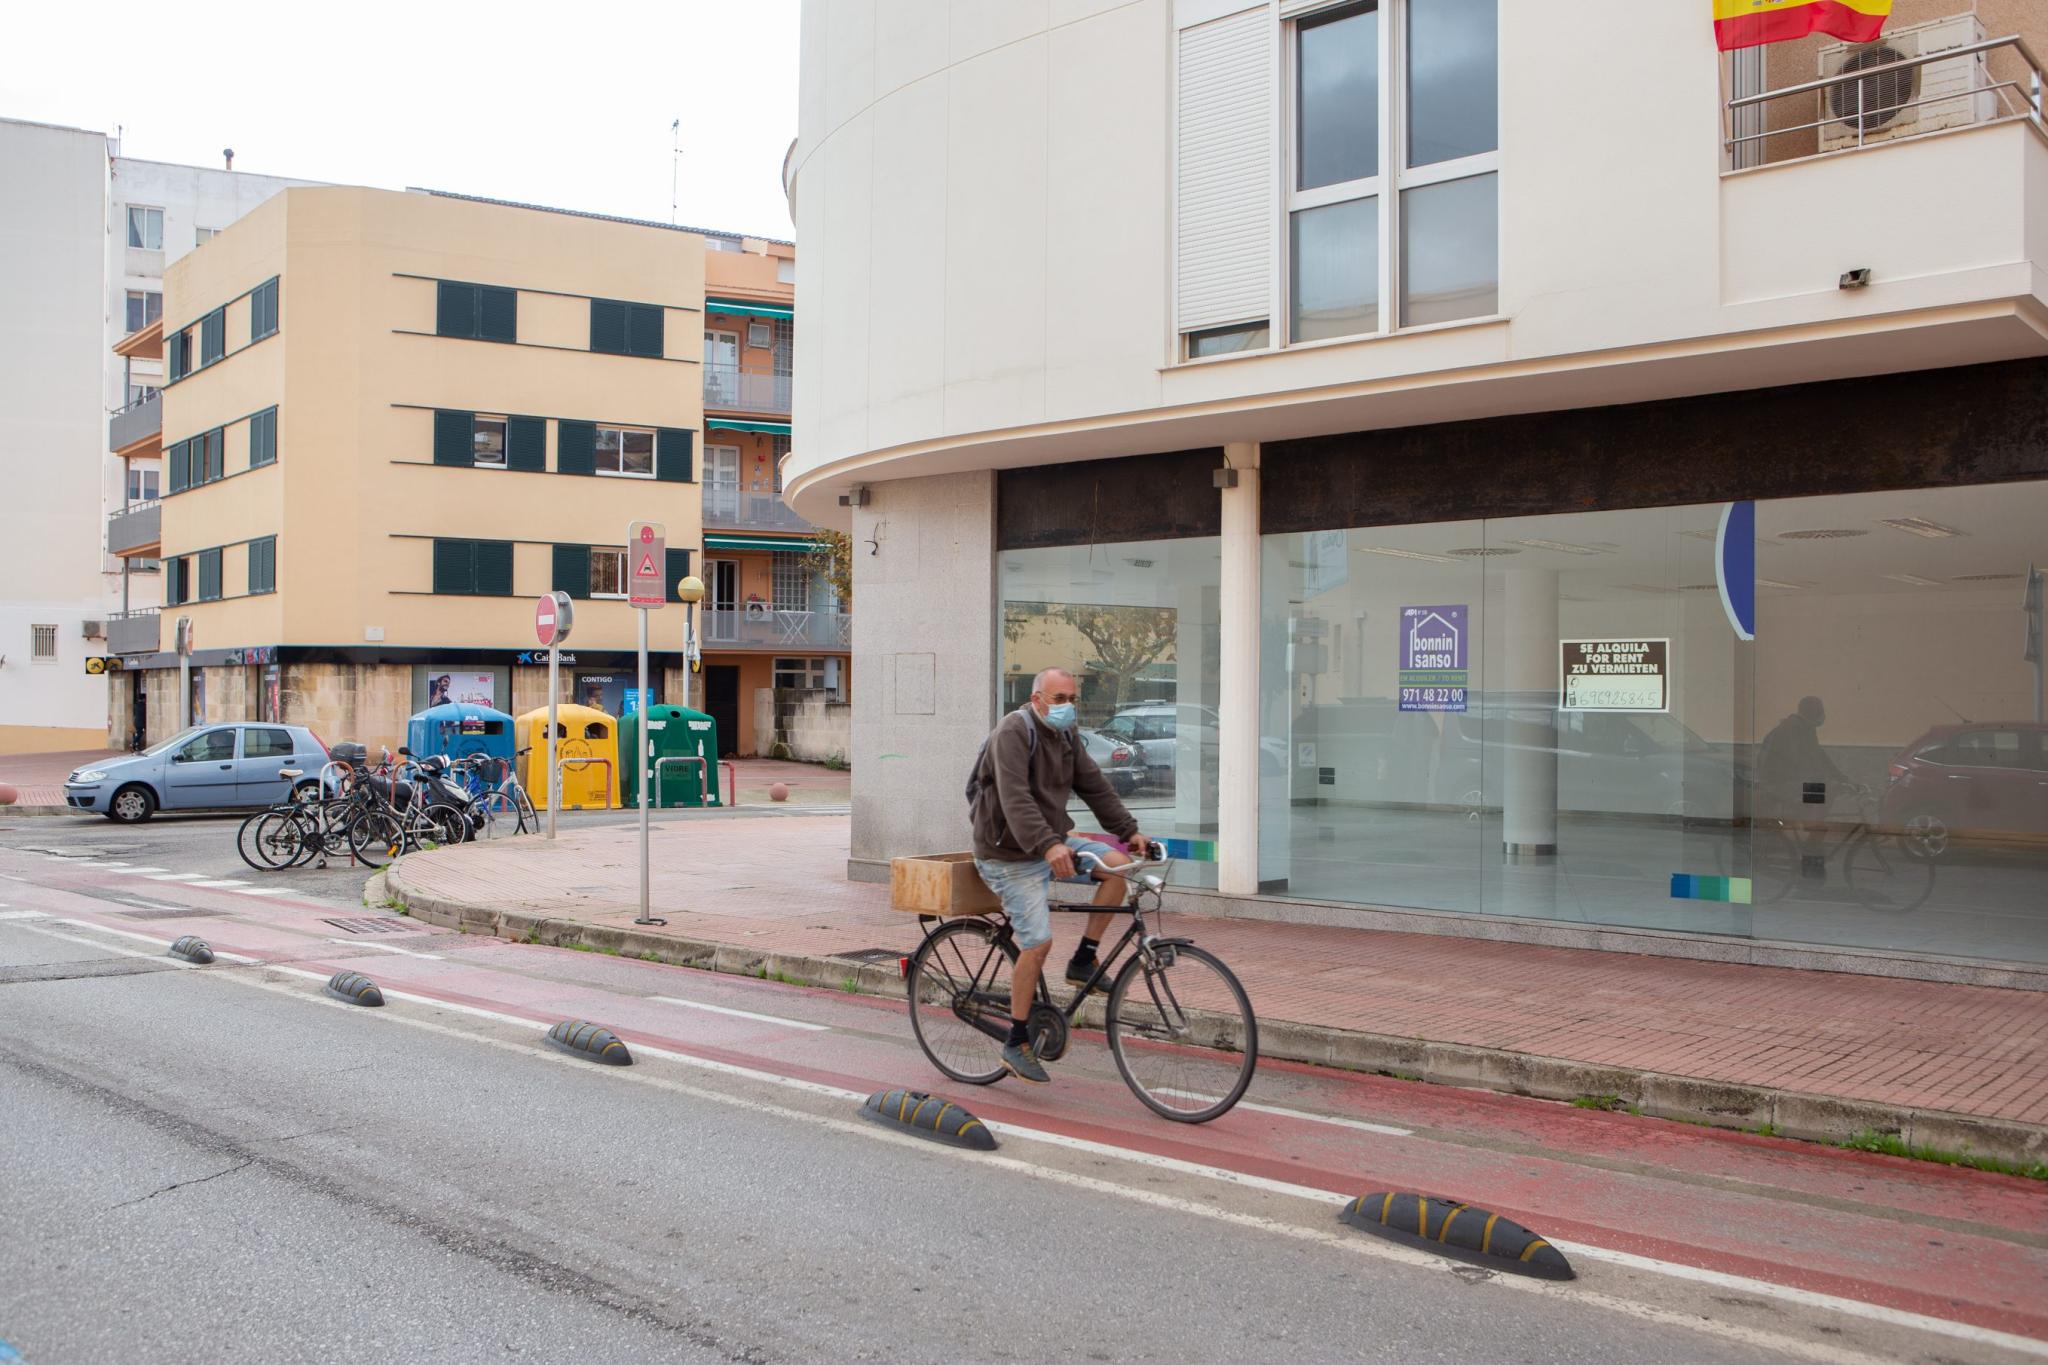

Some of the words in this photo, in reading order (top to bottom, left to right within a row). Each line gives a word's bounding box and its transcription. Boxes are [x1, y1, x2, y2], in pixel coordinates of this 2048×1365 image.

[1413, 632, 1453, 651] bonnin
[1580, 643, 1593, 653] SE
[1596, 643, 1650, 653] ALQUILA
[534, 652, 576, 662] CaiBank
[1414, 654, 1451, 668] sanso
[1586, 653, 1610, 663] FOR
[1613, 653, 1644, 663] RENT
[1571, 664, 1588, 674] ZU
[1591, 663, 1658, 674] VERMIETEN
[1403, 688, 1420, 701] 971
[1423, 688, 1435, 701] 48
[1437, 688, 1449, 701] 22
[1451, 688, 1463, 701] 00
